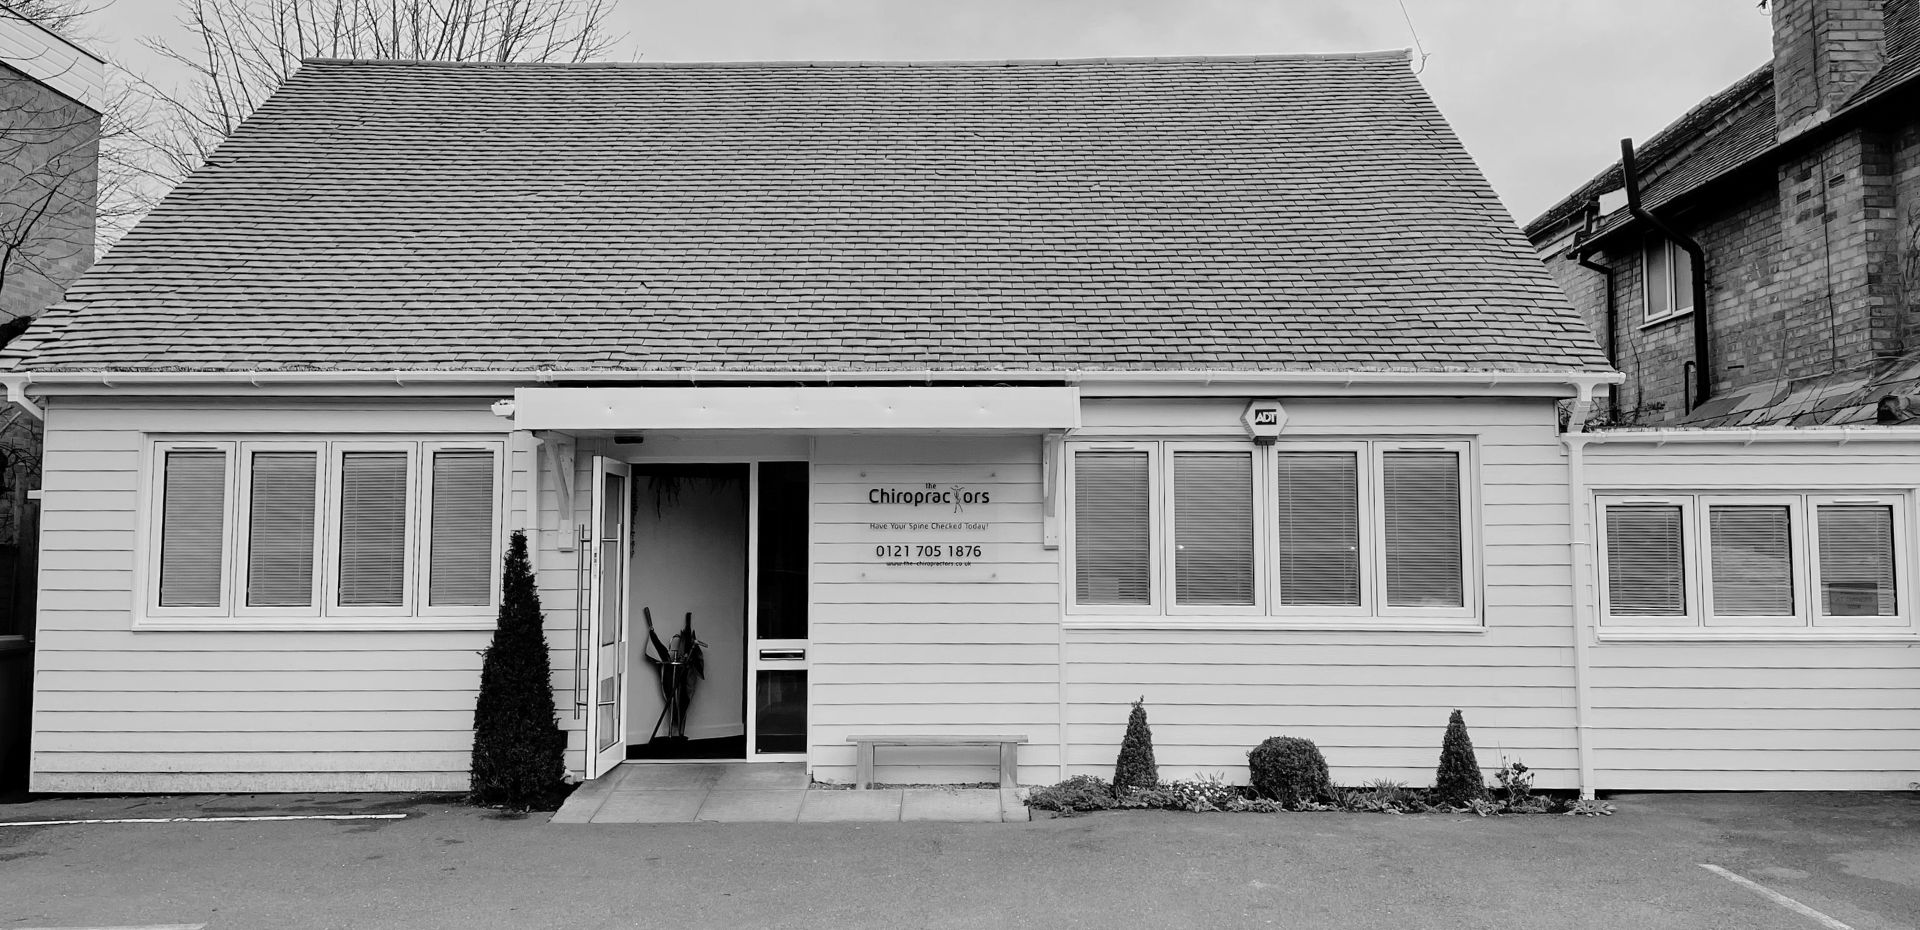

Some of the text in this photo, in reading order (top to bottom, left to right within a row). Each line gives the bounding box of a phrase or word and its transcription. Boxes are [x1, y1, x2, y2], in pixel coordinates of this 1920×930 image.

[1255, 411, 1277, 423] ADT
[909, 522, 929, 531] Spine
[931, 522, 963, 530] Checked
[965, 522, 989, 531] Today!
[876, 545, 982, 557] 0121 705 1876
